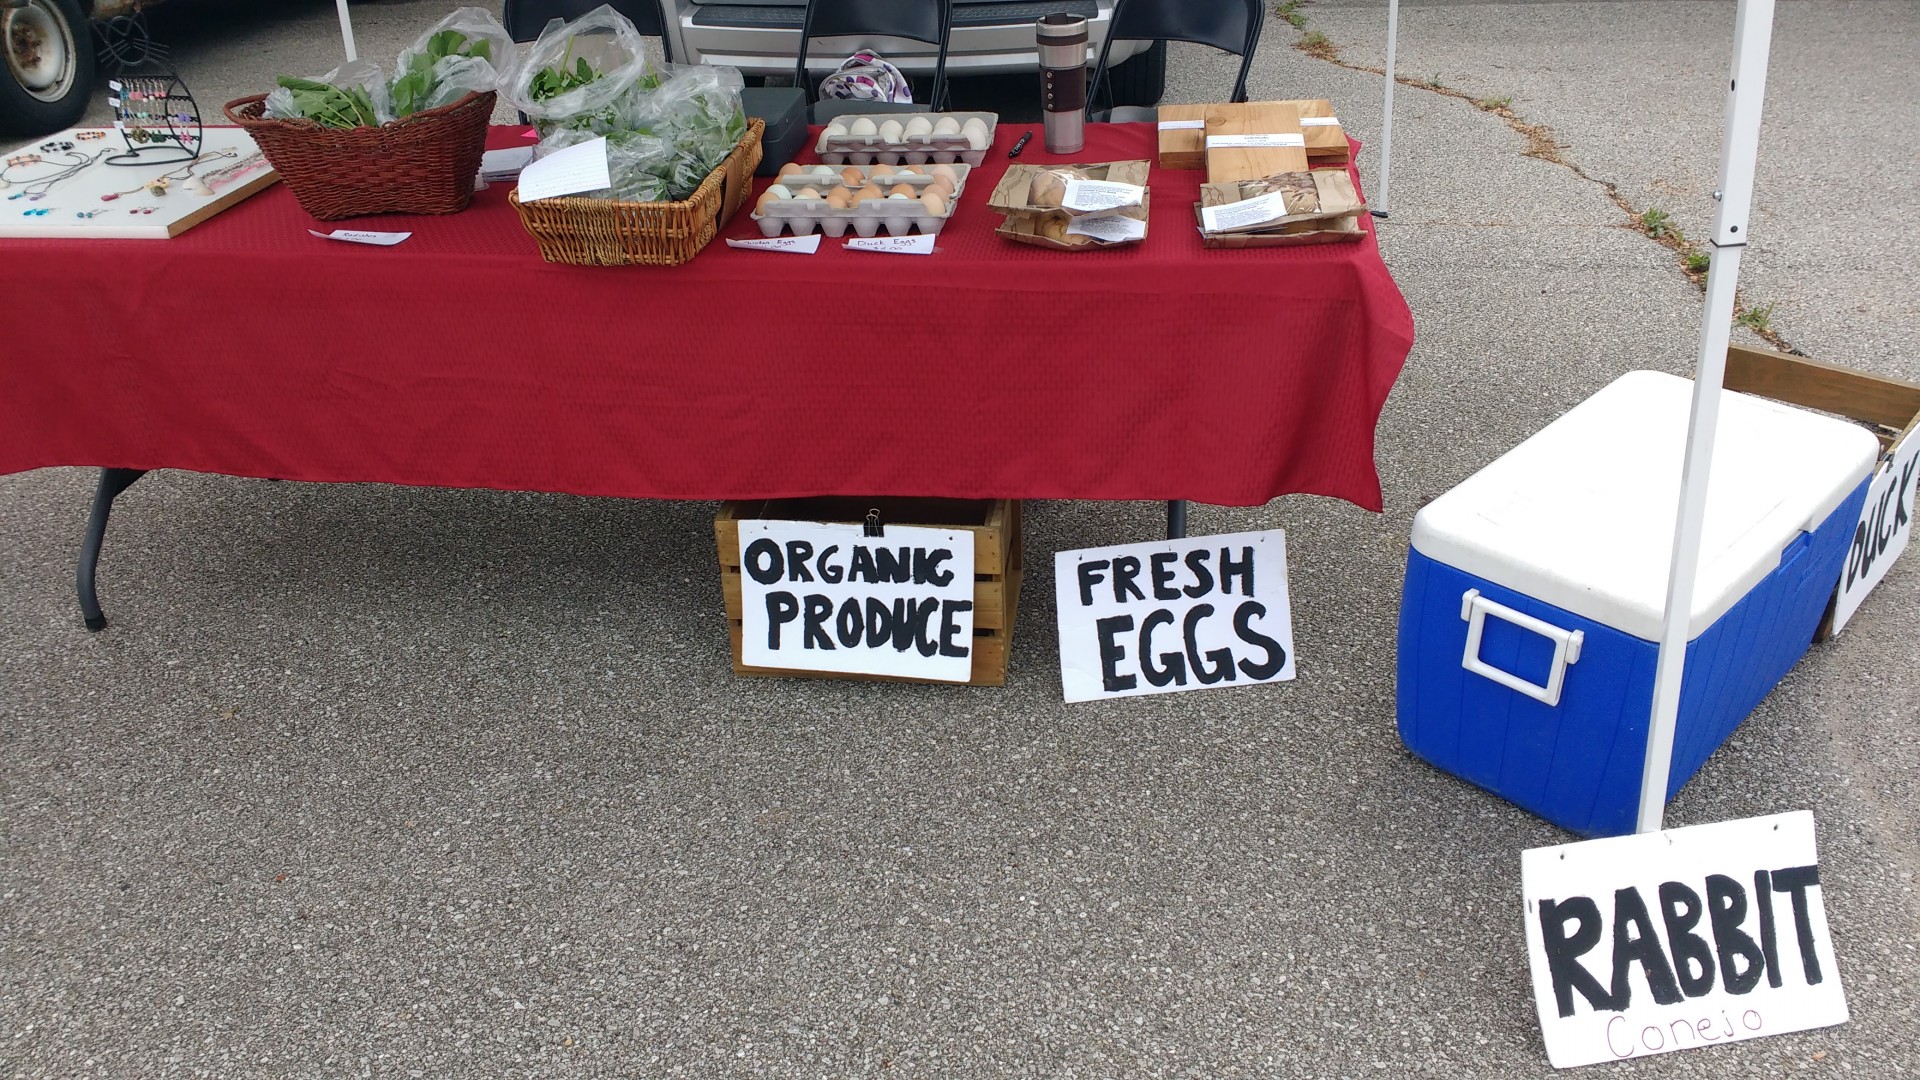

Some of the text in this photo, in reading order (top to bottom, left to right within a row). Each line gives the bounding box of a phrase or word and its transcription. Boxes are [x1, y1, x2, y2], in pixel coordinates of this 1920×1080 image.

[893, 238, 917, 247] Eggs
[1845, 448, 1920, 595] DUCK
[744, 538, 954, 587] ORGANIC
[1077, 546, 1255, 606] FRESH
[765, 591, 973, 658] PRODUCE
[1096, 600, 1286, 692] EGGS
[1538, 864, 1823, 1018] RABBIT
[1607, 1009, 1762, 1058] Conejo
